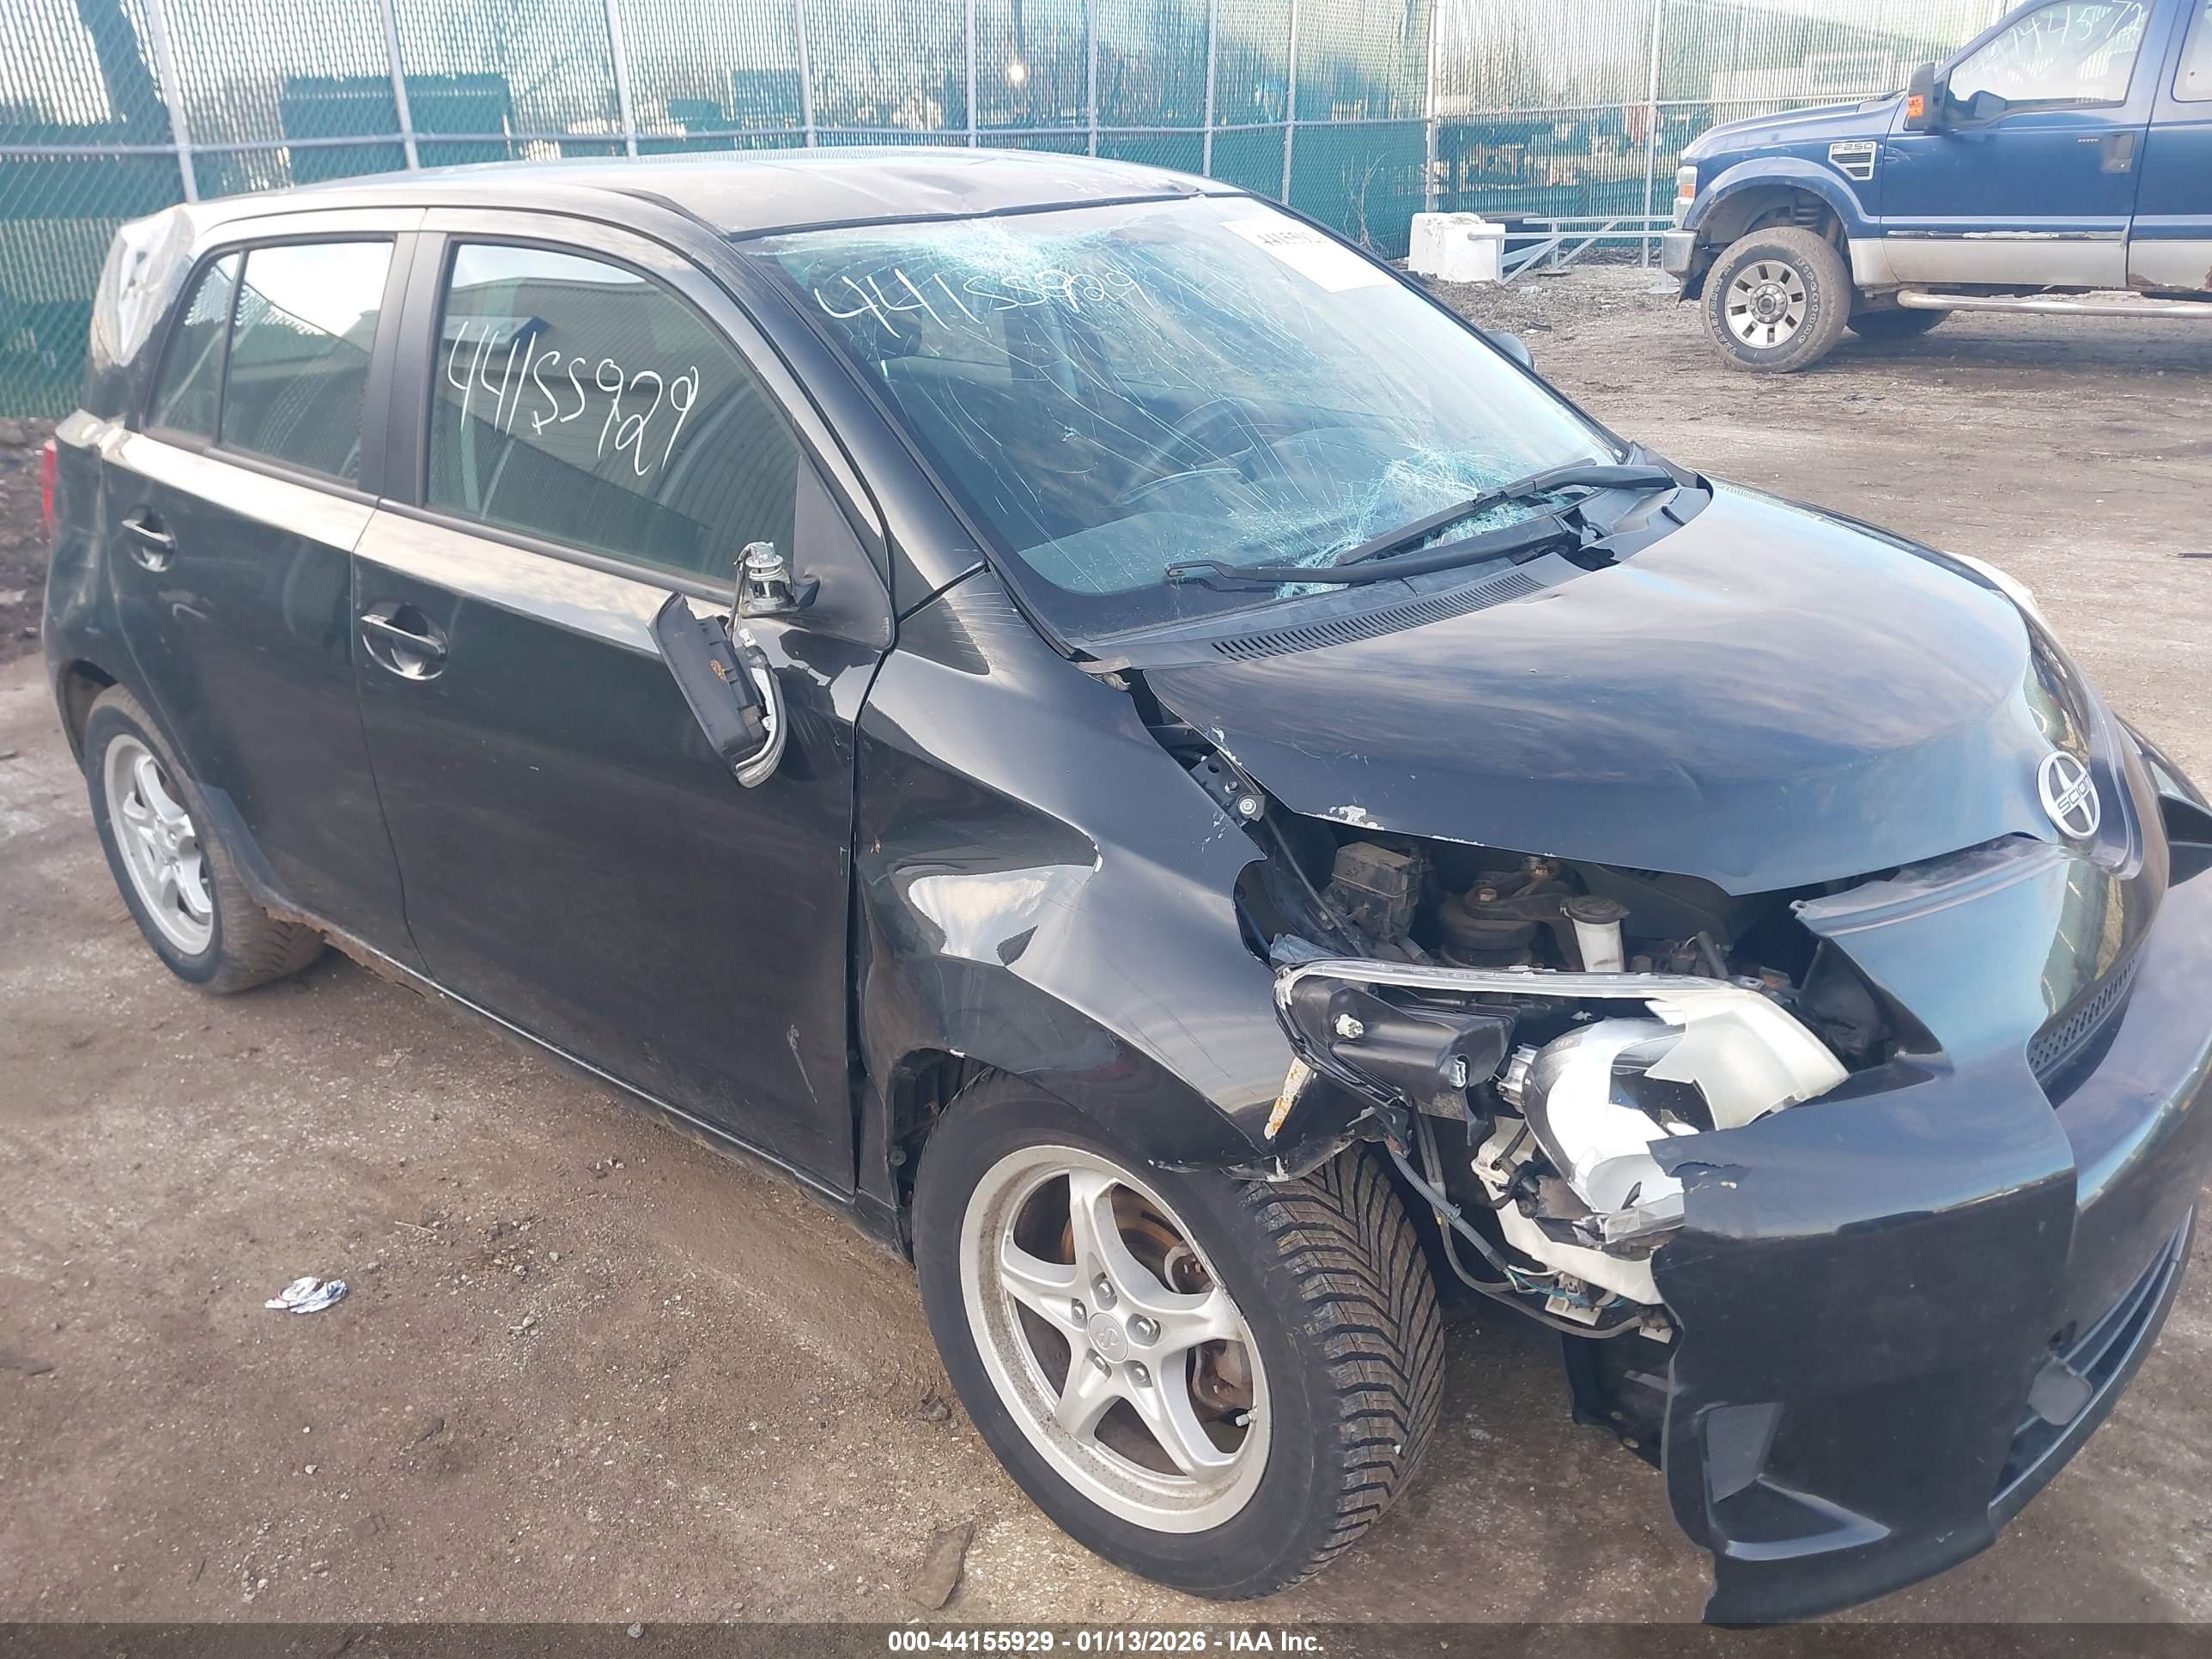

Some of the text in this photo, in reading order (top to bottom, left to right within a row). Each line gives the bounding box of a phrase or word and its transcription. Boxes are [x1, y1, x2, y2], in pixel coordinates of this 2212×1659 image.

[1832, 143, 1874, 152] F-250
[814, 267, 1157, 338] 44155929
[447, 320, 699, 476] 44155929
